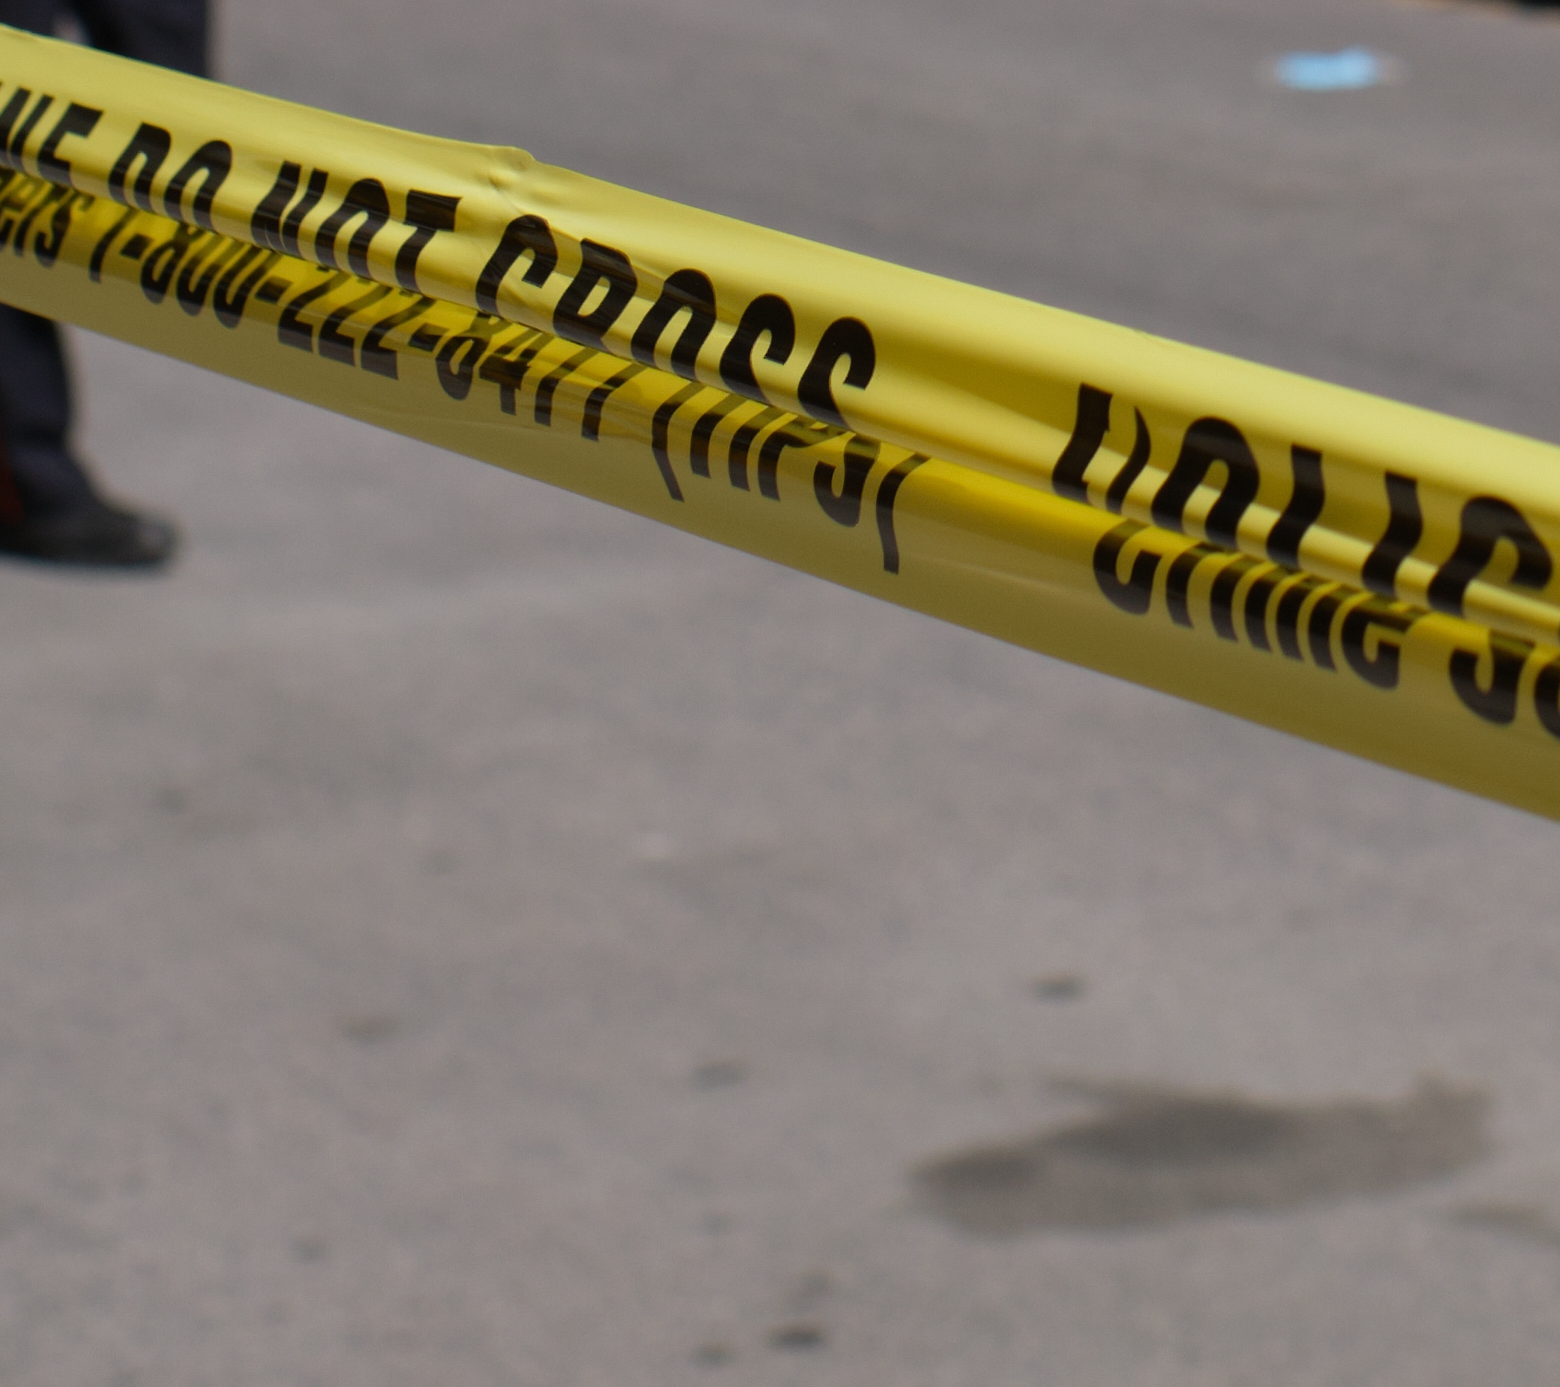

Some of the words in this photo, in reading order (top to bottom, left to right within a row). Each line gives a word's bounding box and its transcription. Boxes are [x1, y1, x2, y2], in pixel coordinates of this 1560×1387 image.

[107, 121, 233, 231] DO
[250, 158, 463, 293] NOT
[476, 212, 877, 432] CROSS
